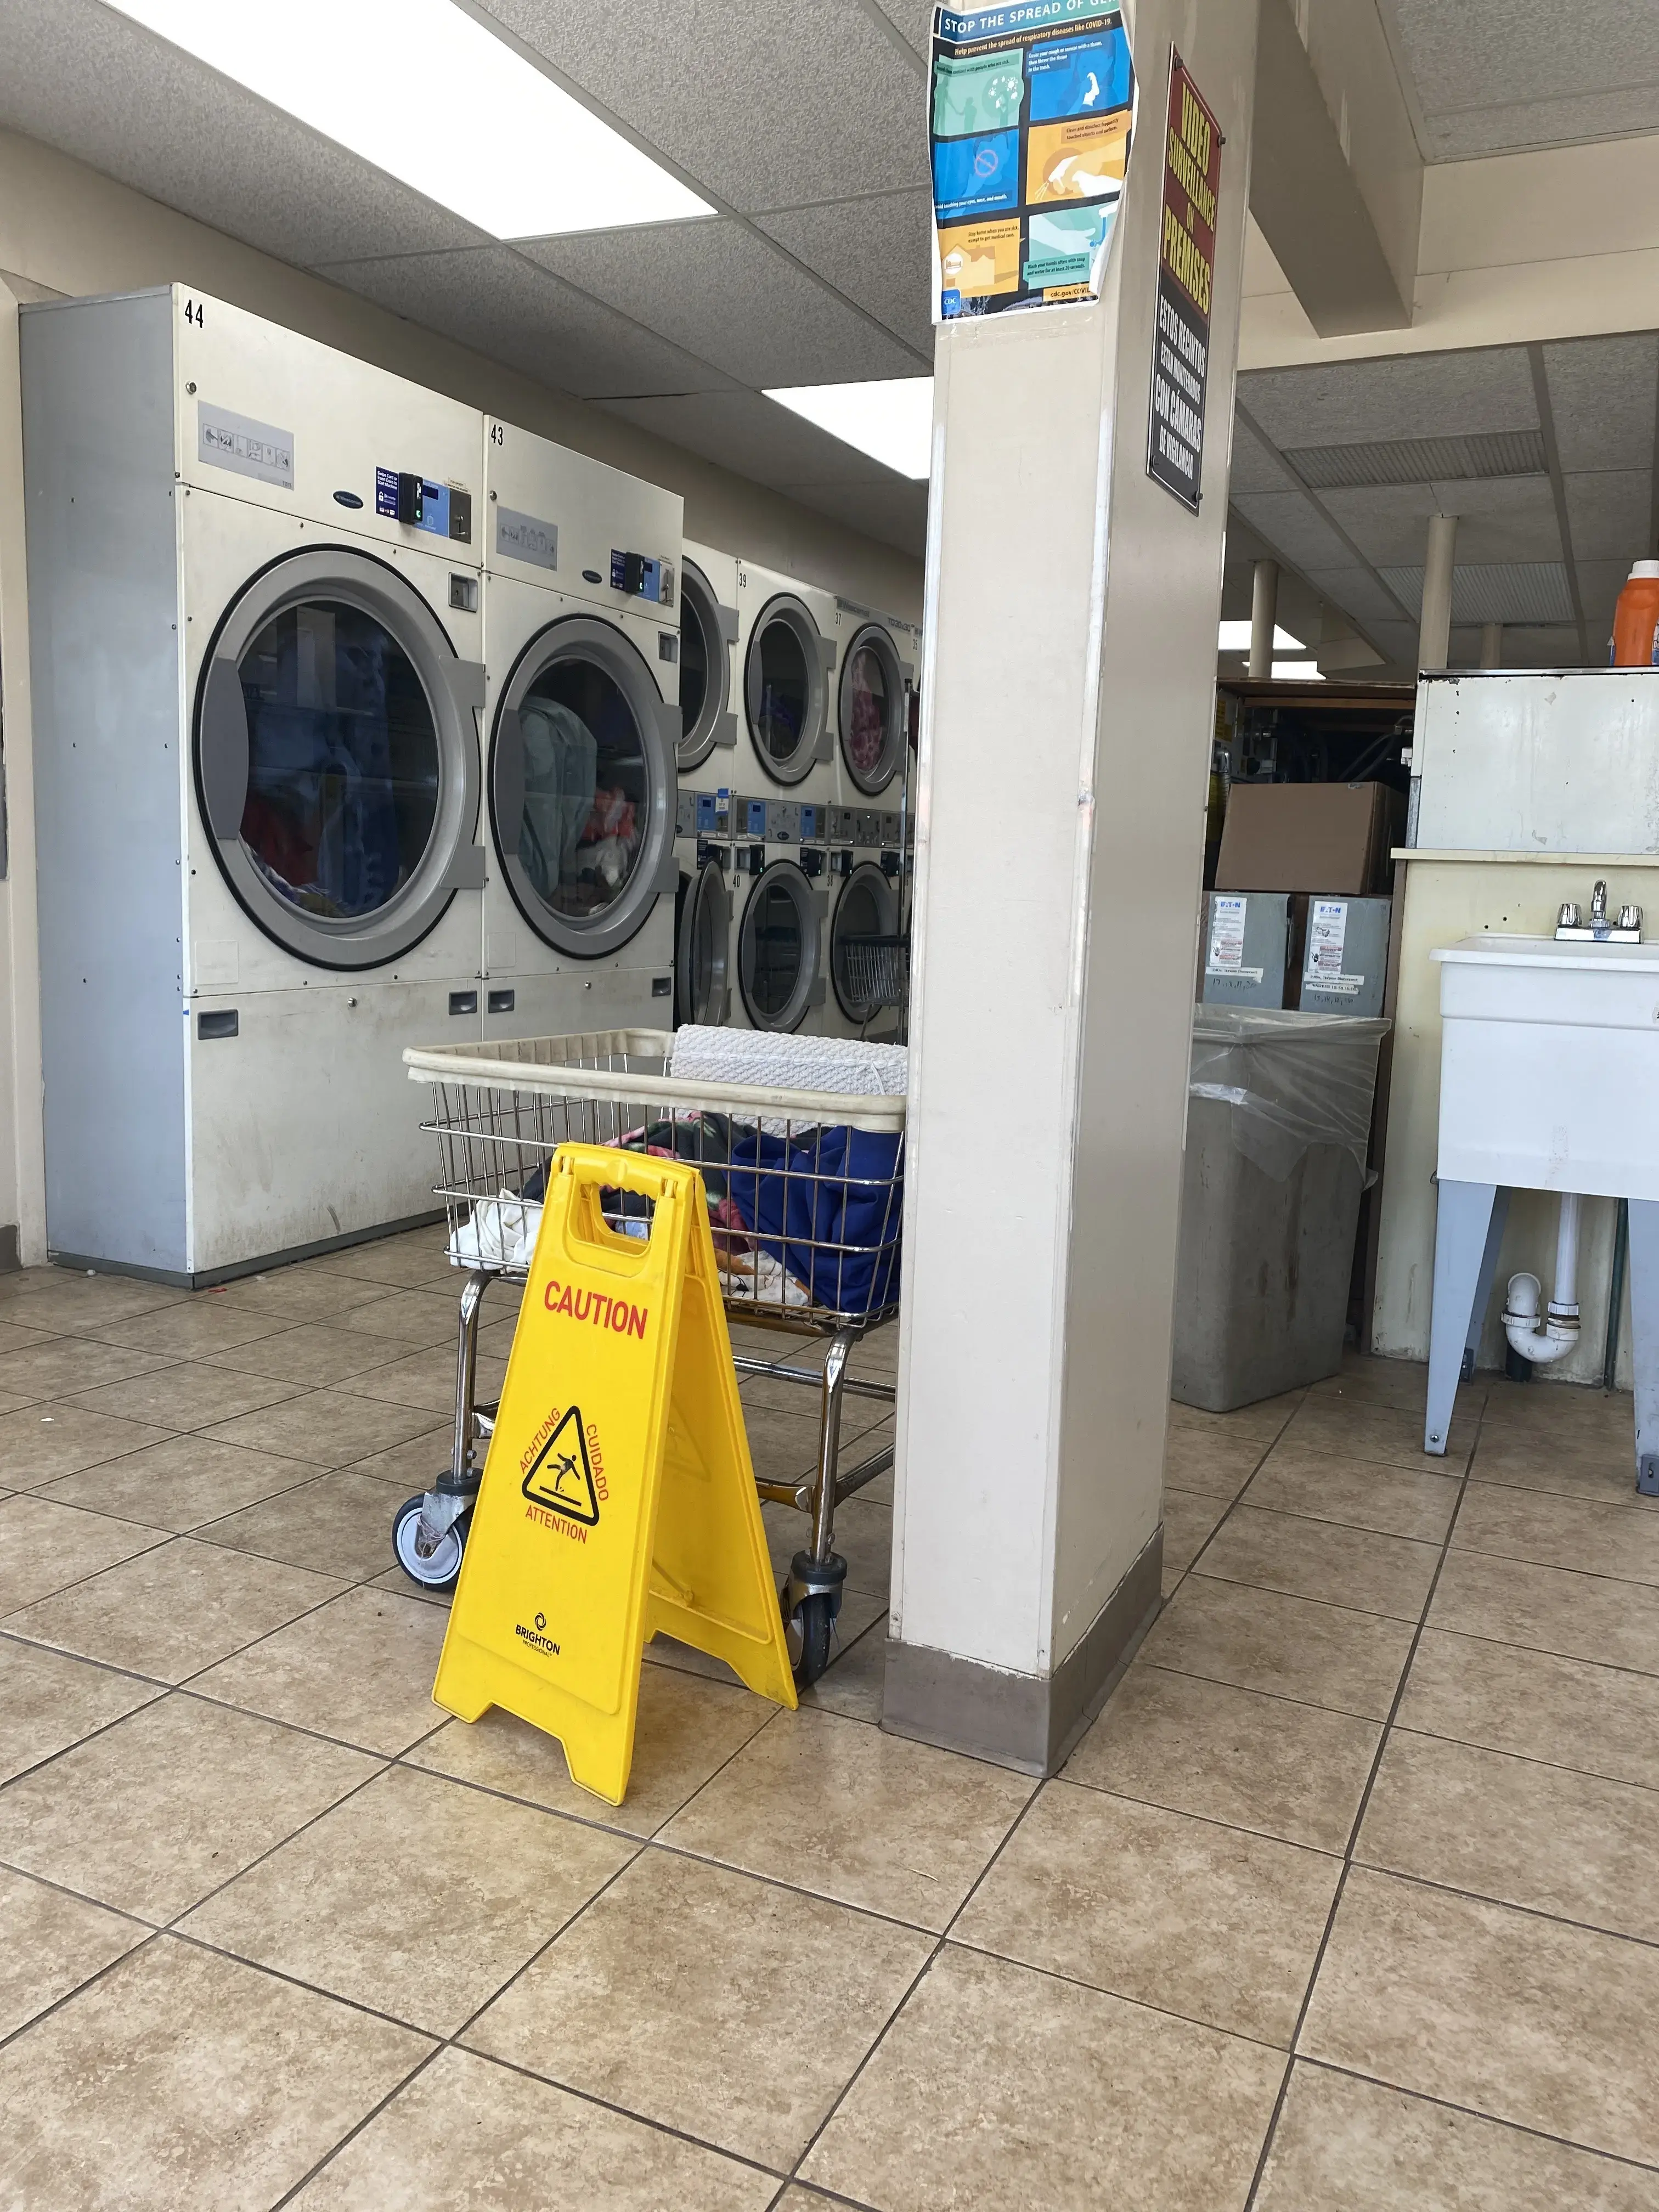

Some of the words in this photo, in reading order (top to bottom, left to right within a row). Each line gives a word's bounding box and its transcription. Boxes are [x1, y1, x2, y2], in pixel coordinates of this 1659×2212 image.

[945, 18, 975, 33] STOP
[979, 14, 1005, 29] THE
[1009, 2, 1061, 23] SPREAD
[1066, 0, 1084, 10] OF
[955, 47, 967, 55] Help
[968, 43, 988, 54] prevent
[997, 37, 1015, 48] spread
[1023, 30, 1051, 42] respiratory
[1052, 26, 1074, 36] diseases
[1075, 24, 1085, 32] like
[1086, 18, 1112, 30] COVID-19.
[1181, 82, 1211, 176] VIDEO
[1169, 126, 1216, 232] SURVEILLANCE
[1187, 202, 1194, 234] ON
[1163, 204, 1210, 314] PREMISES
[185, 299, 203, 329] 44
[1160, 294, 1178, 346] ESTOS
[1178, 318, 1205, 378] RECINTOS
[1161, 341, 1173, 375] ESTAN
[1155, 373, 1170, 421] CON
[1170, 389, 1201, 453] CÁMARAS
[491, 424, 503, 446] 43
[1159, 424, 1166, 455] DE
[1166, 431, 1193, 481] VIGILANCIA
[739, 572, 747, 588] 39
[835, 612, 842, 625] 37
[733, 874, 741, 888] 40
[544, 1280, 648, 1340] CAUTION
[520, 1408, 560, 1474] ACHTUNG
[586, 1424, 609, 1501] CUIDADO
[525, 1504, 588, 1544] ATTENTION
[515, 1624, 561, 1655] BRIGHTON
